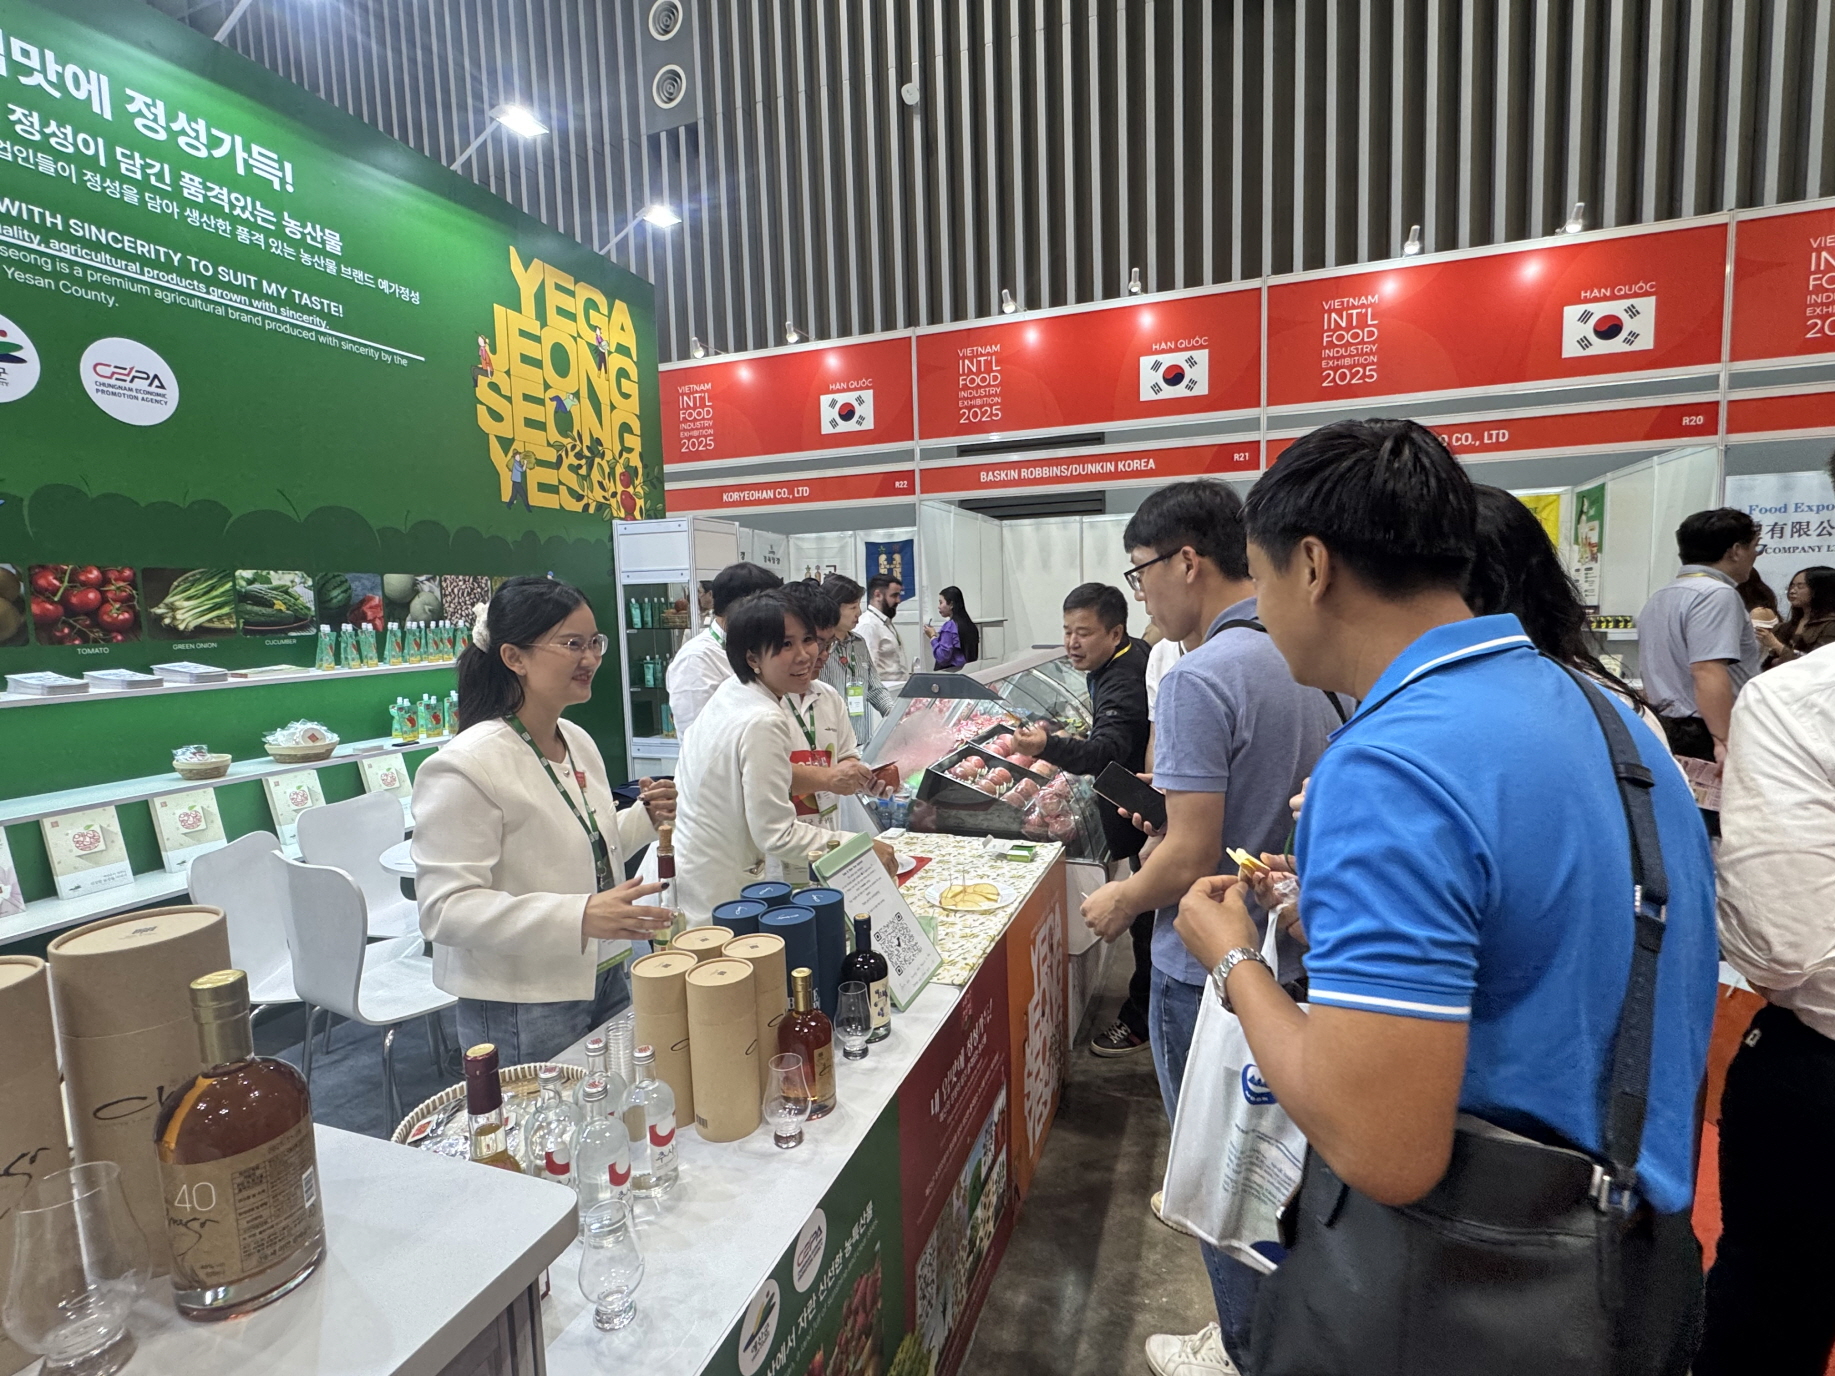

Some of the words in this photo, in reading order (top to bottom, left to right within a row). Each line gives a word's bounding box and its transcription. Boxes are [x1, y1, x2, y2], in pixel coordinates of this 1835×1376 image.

[0, 28, 112, 121] 맛에
[125, 87, 294, 194] 정성가득!
[7, 103, 106, 167] 정성이
[115, 146, 172, 192] 담긴
[179, 170, 276, 230] 품격있는
[282, 211, 343, 256] 농산물
[0, 139, 77, 184] 업인들이
[82, 169, 140, 206] 정성을
[145, 192, 180, 220] 담아
[184, 207, 231, 238] 생산한
[236, 224, 265, 250] 품격
[269, 238, 297, 261] 있는
[299, 249, 338, 276] 농산물
[341, 264, 375, 289] 브랜드
[377, 277, 421, 305] 예가정성
[0, 197, 63, 231] WITH
[69, 218, 182, 267] SINCERITY
[187, 255, 213, 276] TO
[218, 266, 258, 291] SUIT
[262, 280, 288, 300] MY
[291, 289, 344, 318] TASTE!
[3, 264, 55, 290] Yesan
[59, 281, 119, 308] County.
[50, 239, 140, 275] agricultural
[144, 265, 206, 294] products
[209, 285, 250, 307] grown
[251, 296, 278, 314] with
[280, 306, 330, 331] sincerity.
[0, 245, 52, 272] seong
[56, 258, 70, 274] is
[73, 265, 83, 277] a
[87, 269, 151, 297] premium
[154, 287, 225, 317] agricultural
[228, 306, 262, 327] brand
[265, 318, 316, 342] produced
[317, 332, 339, 348] with
[341, 338, 380, 361] sincerity
[381, 352, 392, 364] by
[393, 354, 408, 367] the
[509, 245, 637, 361] YEGA
[1322, 294, 1379, 310] VIETNAM
[1323, 307, 1378, 330] INT'L
[1323, 327, 1378, 346] FOOD
[478, 303, 639, 415] JEONG
[958, 344, 1001, 357] VIETNAM
[1322, 343, 1378, 358] INDUSTRY
[959, 356, 1001, 373] INT'L
[1321, 355, 1378, 368] EXHIBITION
[92, 362, 167, 390] CEPA
[959, 373, 1001, 388] FOOD
[1321, 365, 1378, 387] 2025
[95, 380, 134, 393] CHUNGNAM
[134, 387, 168, 399] ECONOMIC
[678, 382, 712, 394] VIETNAM
[958, 387, 1001, 398] INDUSTRY
[95, 388, 139, 401] PROMOTION
[141, 396, 168, 406] AGENCY
[679, 393, 712, 409] INT'L
[958, 396, 1001, 407] EXHIBITION
[476, 368, 642, 469] SEONG
[679, 408, 713, 421] FOOD
[959, 406, 1002, 424] 2025
[1682, 415, 1704, 426] R20
[679, 420, 713, 430] INDUSTRY
[680, 429, 714, 438] EXHIBITION
[680, 436, 715, 452] 2025
[1452, 432, 1480, 447] CO.,
[1483, 429, 1509, 443] LTD
[1233, 452, 1250, 462] R21
[980, 468, 1019, 482] BASKIN
[1021, 461, 1115, 480] ROBBINS/DUNKIN
[1117, 458, 1156, 471] KOREA
[723, 490, 774, 502] KORYEOHAN
[775, 488, 793, 500] CO.,
[794, 487, 810, 498] LTD
[1748, 503, 1788, 515] Food
[1764, 545, 1823, 555] COMPANY
[172, 642, 194, 650] GREEN
[195, 641, 218, 649] ONION
[264, 637, 297, 646] CUCUMBER
[76, 646, 110, 655] TOMATO
[174, 1181, 216, 1212] 40
[797, 1292, 817, 1334] 자란
[818, 1249, 843, 1300] 신선한
